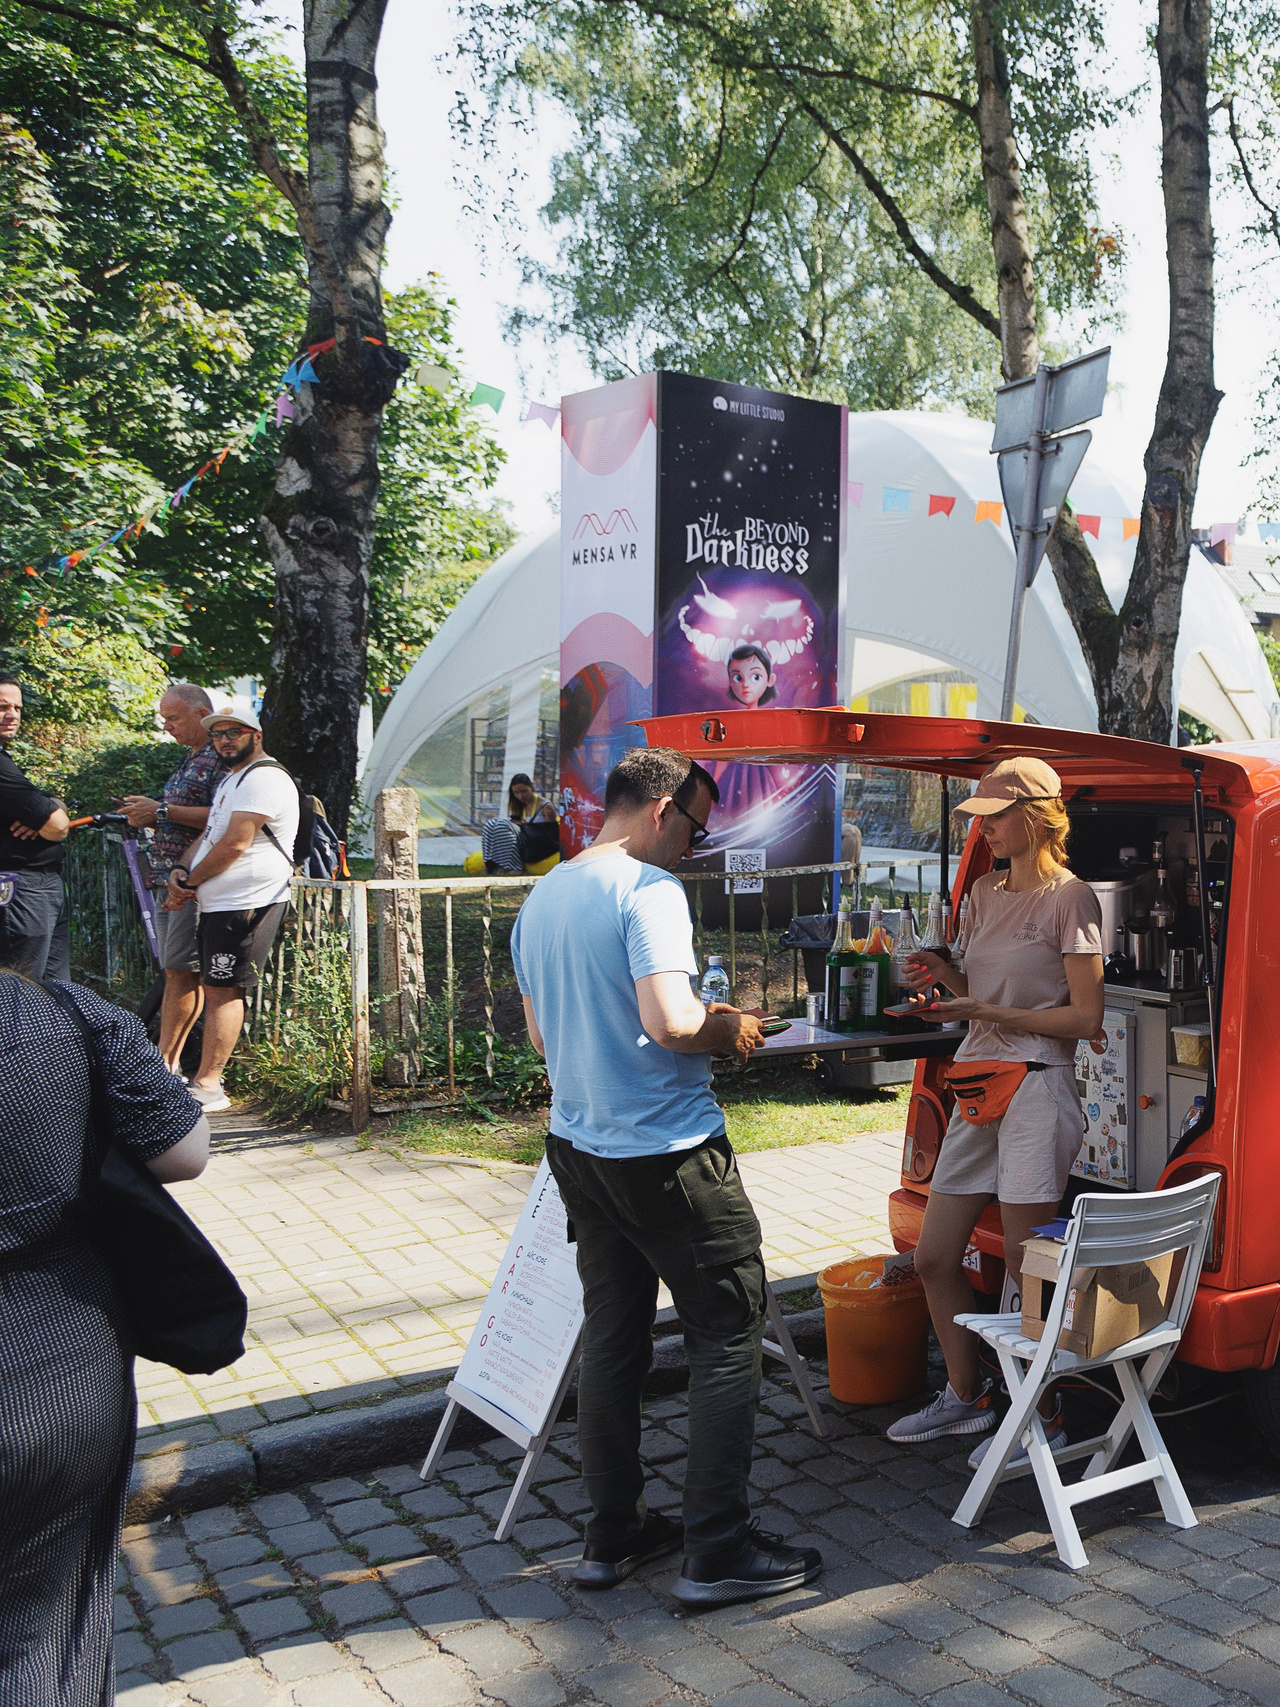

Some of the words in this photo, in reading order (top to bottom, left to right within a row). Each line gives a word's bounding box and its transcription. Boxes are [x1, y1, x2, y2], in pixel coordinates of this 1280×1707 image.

[729, 400, 740, 413] MY
[740, 401, 761, 418] LITTLE
[762, 404, 785, 422] STUDIO
[699, 512, 732, 538] the
[744, 516, 810, 546] BEYOND
[572, 544, 615, 566] MENSA
[620, 543, 637, 560] VR
[685, 522, 809, 575] Darkness
